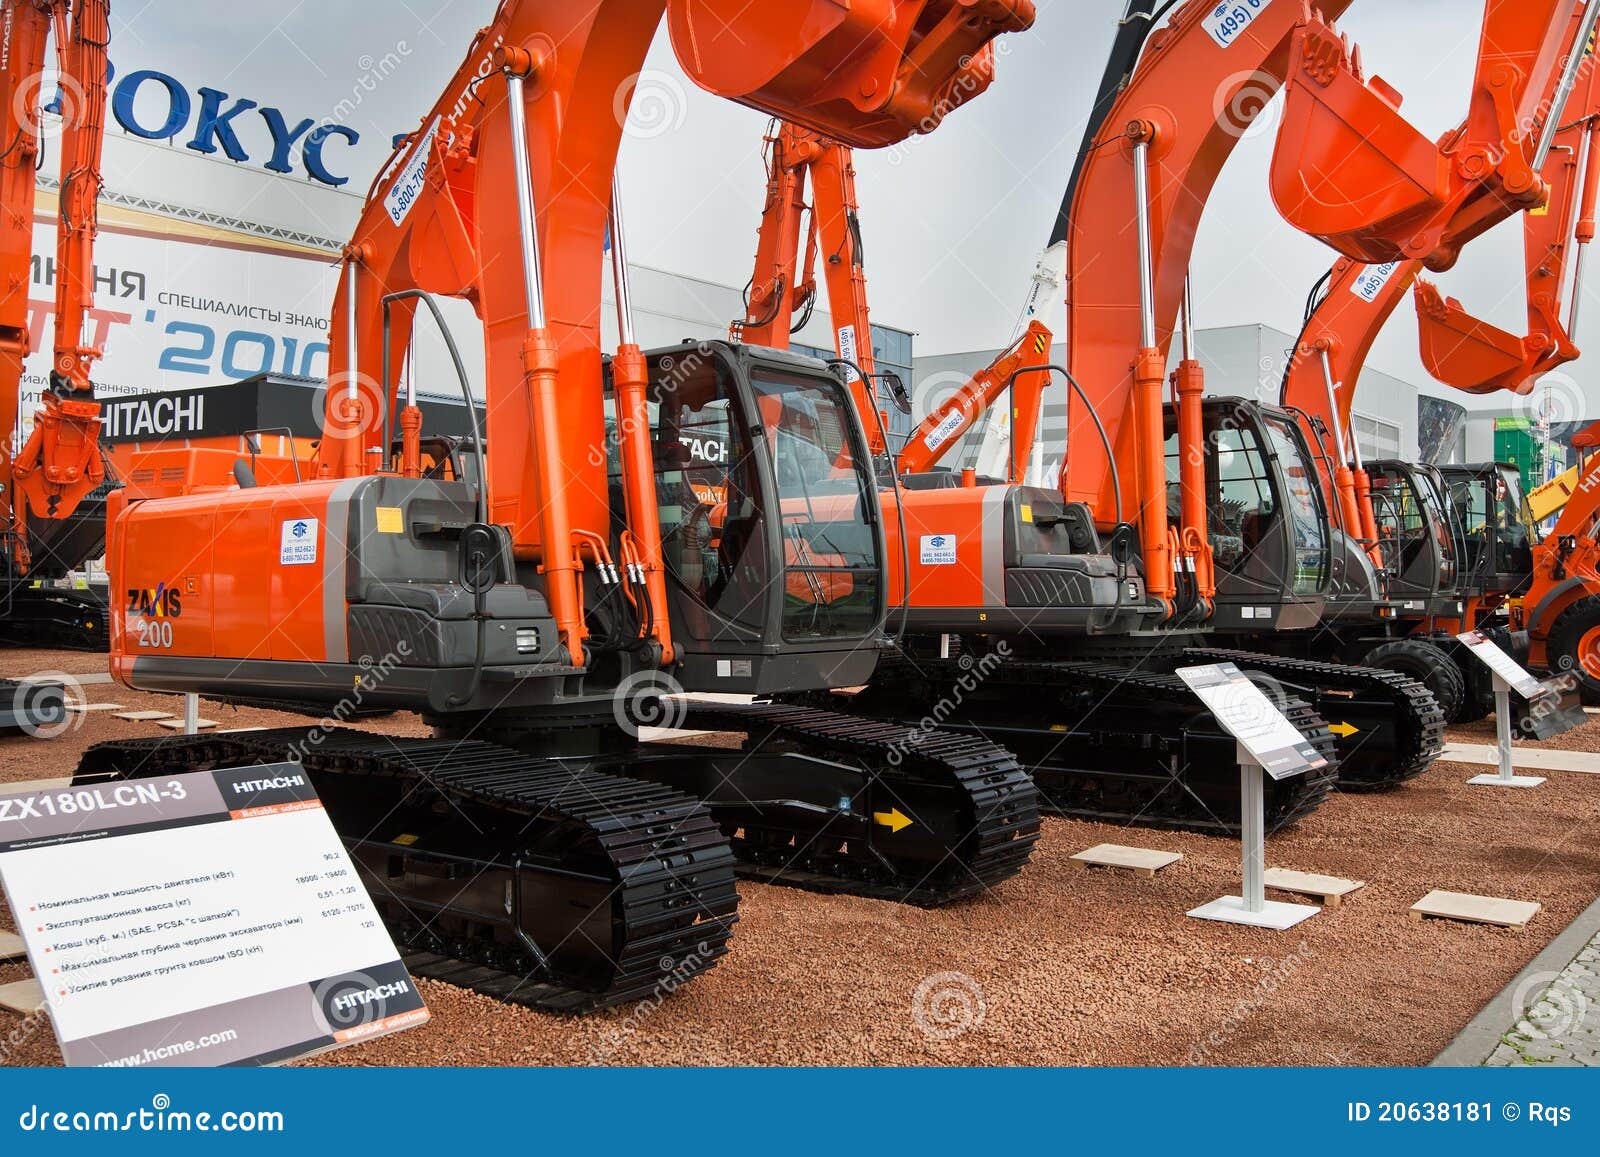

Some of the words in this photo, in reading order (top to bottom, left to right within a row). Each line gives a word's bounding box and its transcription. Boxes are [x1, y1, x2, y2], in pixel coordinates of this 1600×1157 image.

[1, 9, 12, 70] HITACHI
[1214, 5, 1253, 44] (495)
[45, 60, 360, 187] ОКУС
[1360, 275, 1385, 300] (495)
[158, 292, 281, 323] СПЕЦИАЛИСТЫ
[128, 582, 181, 618] ZAXIS
[137, 621, 173, 649] 200
[0, 780, 188, 822] ZX180LCN-3
[233, 775, 305, 794] HITACHI
[38, 892, 110, 911] Номинальная
[112, 884, 162, 898] мощность
[164, 875, 211, 889] двигателя
[212, 870, 235, 882] (кВт)
[45, 907, 143, 931] Эксплуатационная
[144, 902, 174, 912] масса
[360, 920, 375, 929] 120
[53, 941, 83, 951] Ковш
[157, 919, 185, 931] PCSA
[61, 950, 139, 972] Максимальная
[141, 942, 181, 955] глубина
[183, 932, 227, 946] черпания
[229, 921, 283, 938] экскаватора
[283, 917, 304, 926] (мм)
[68, 981, 108, 994] Усилие
[110, 969, 152, 986] резания
[154, 963, 187, 976] грунта
[189, 954, 226, 966] ковшом
[226, 949, 244, 959] ISO
[245, 945, 264, 956] (кН)
[334, 979, 410, 1010] HITACHI
[93, 1028, 239, 1067] ww.hcme.com
